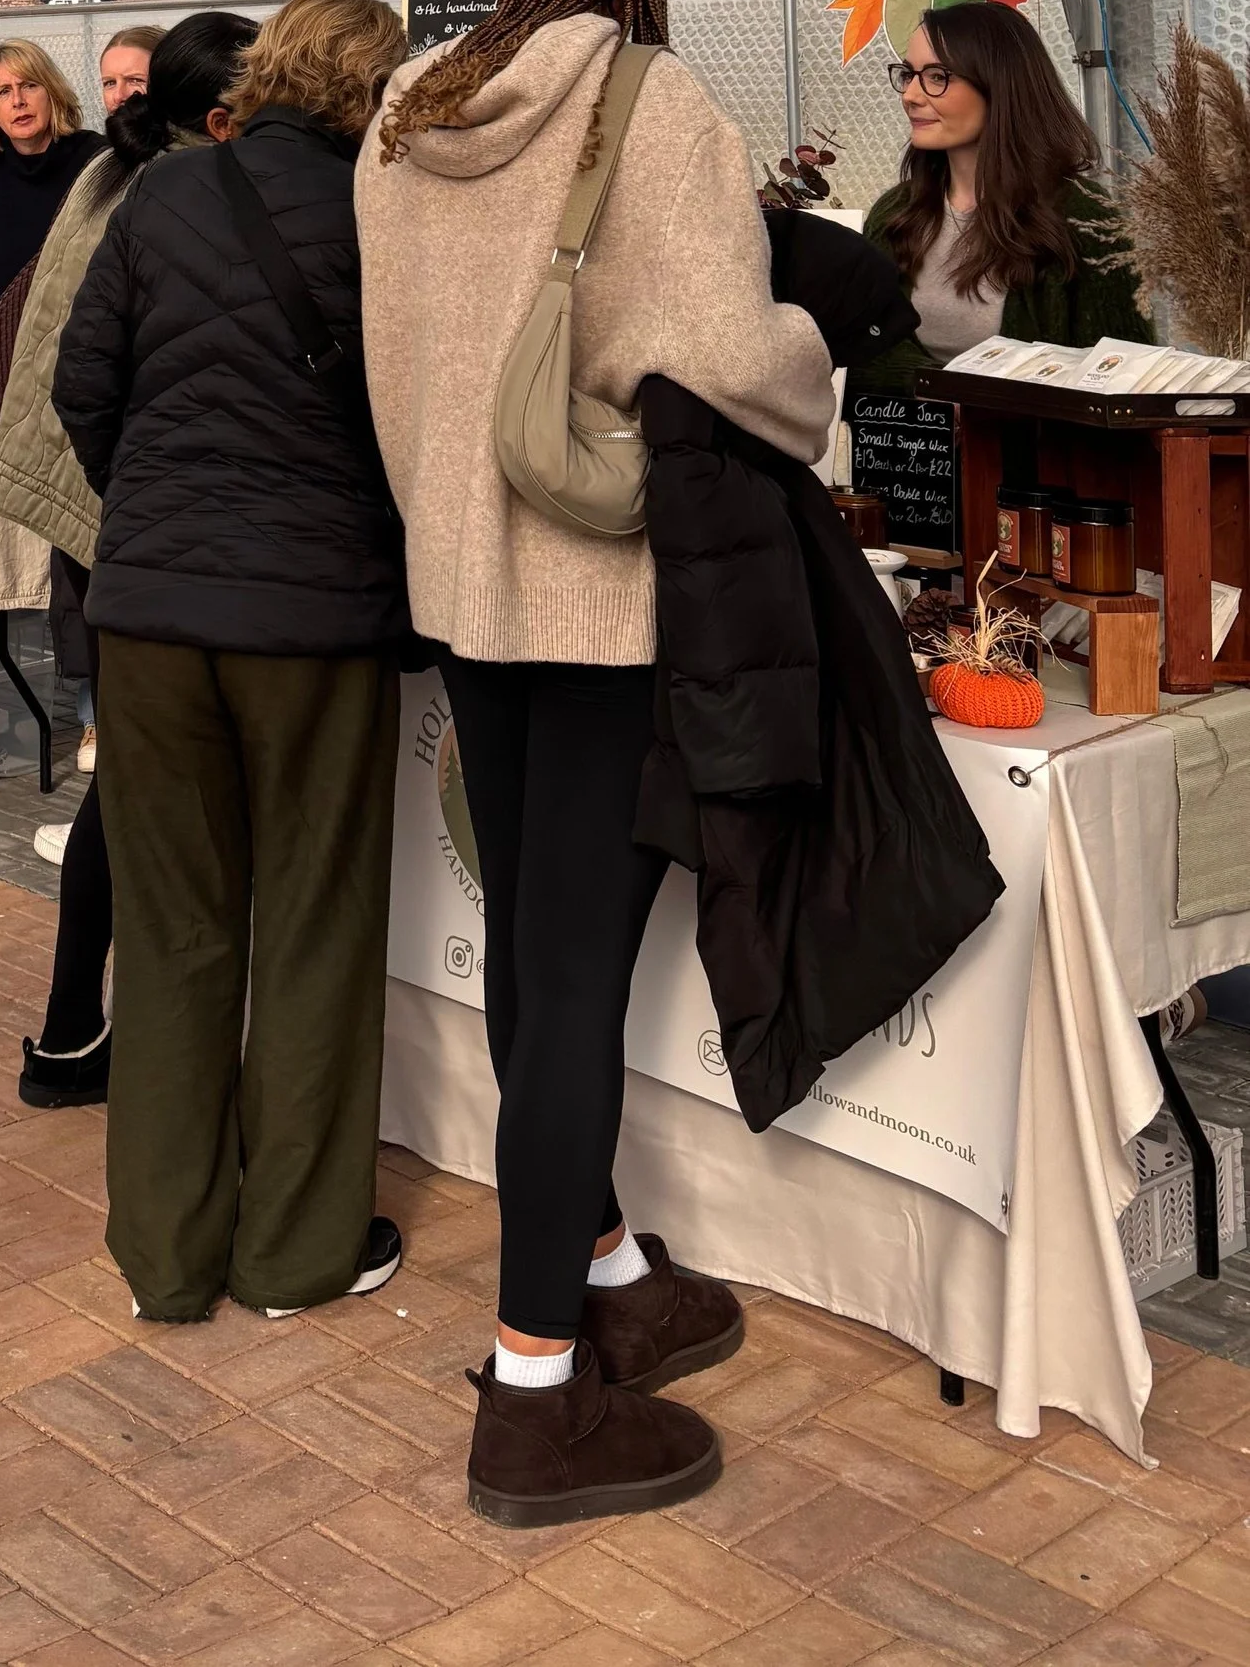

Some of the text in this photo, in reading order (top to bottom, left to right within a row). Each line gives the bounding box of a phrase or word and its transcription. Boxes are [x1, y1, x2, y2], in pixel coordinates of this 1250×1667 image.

[425, 0, 498, 15] All handmad
[854, 397, 946, 424] Candle Jars
[858, 428, 949, 457] Small Single Wick
[907, 457, 915, 473] 2
[929, 457, 952, 477] £22
[893, 484, 921, 501] Double
[414, 696, 452, 769] HOL
